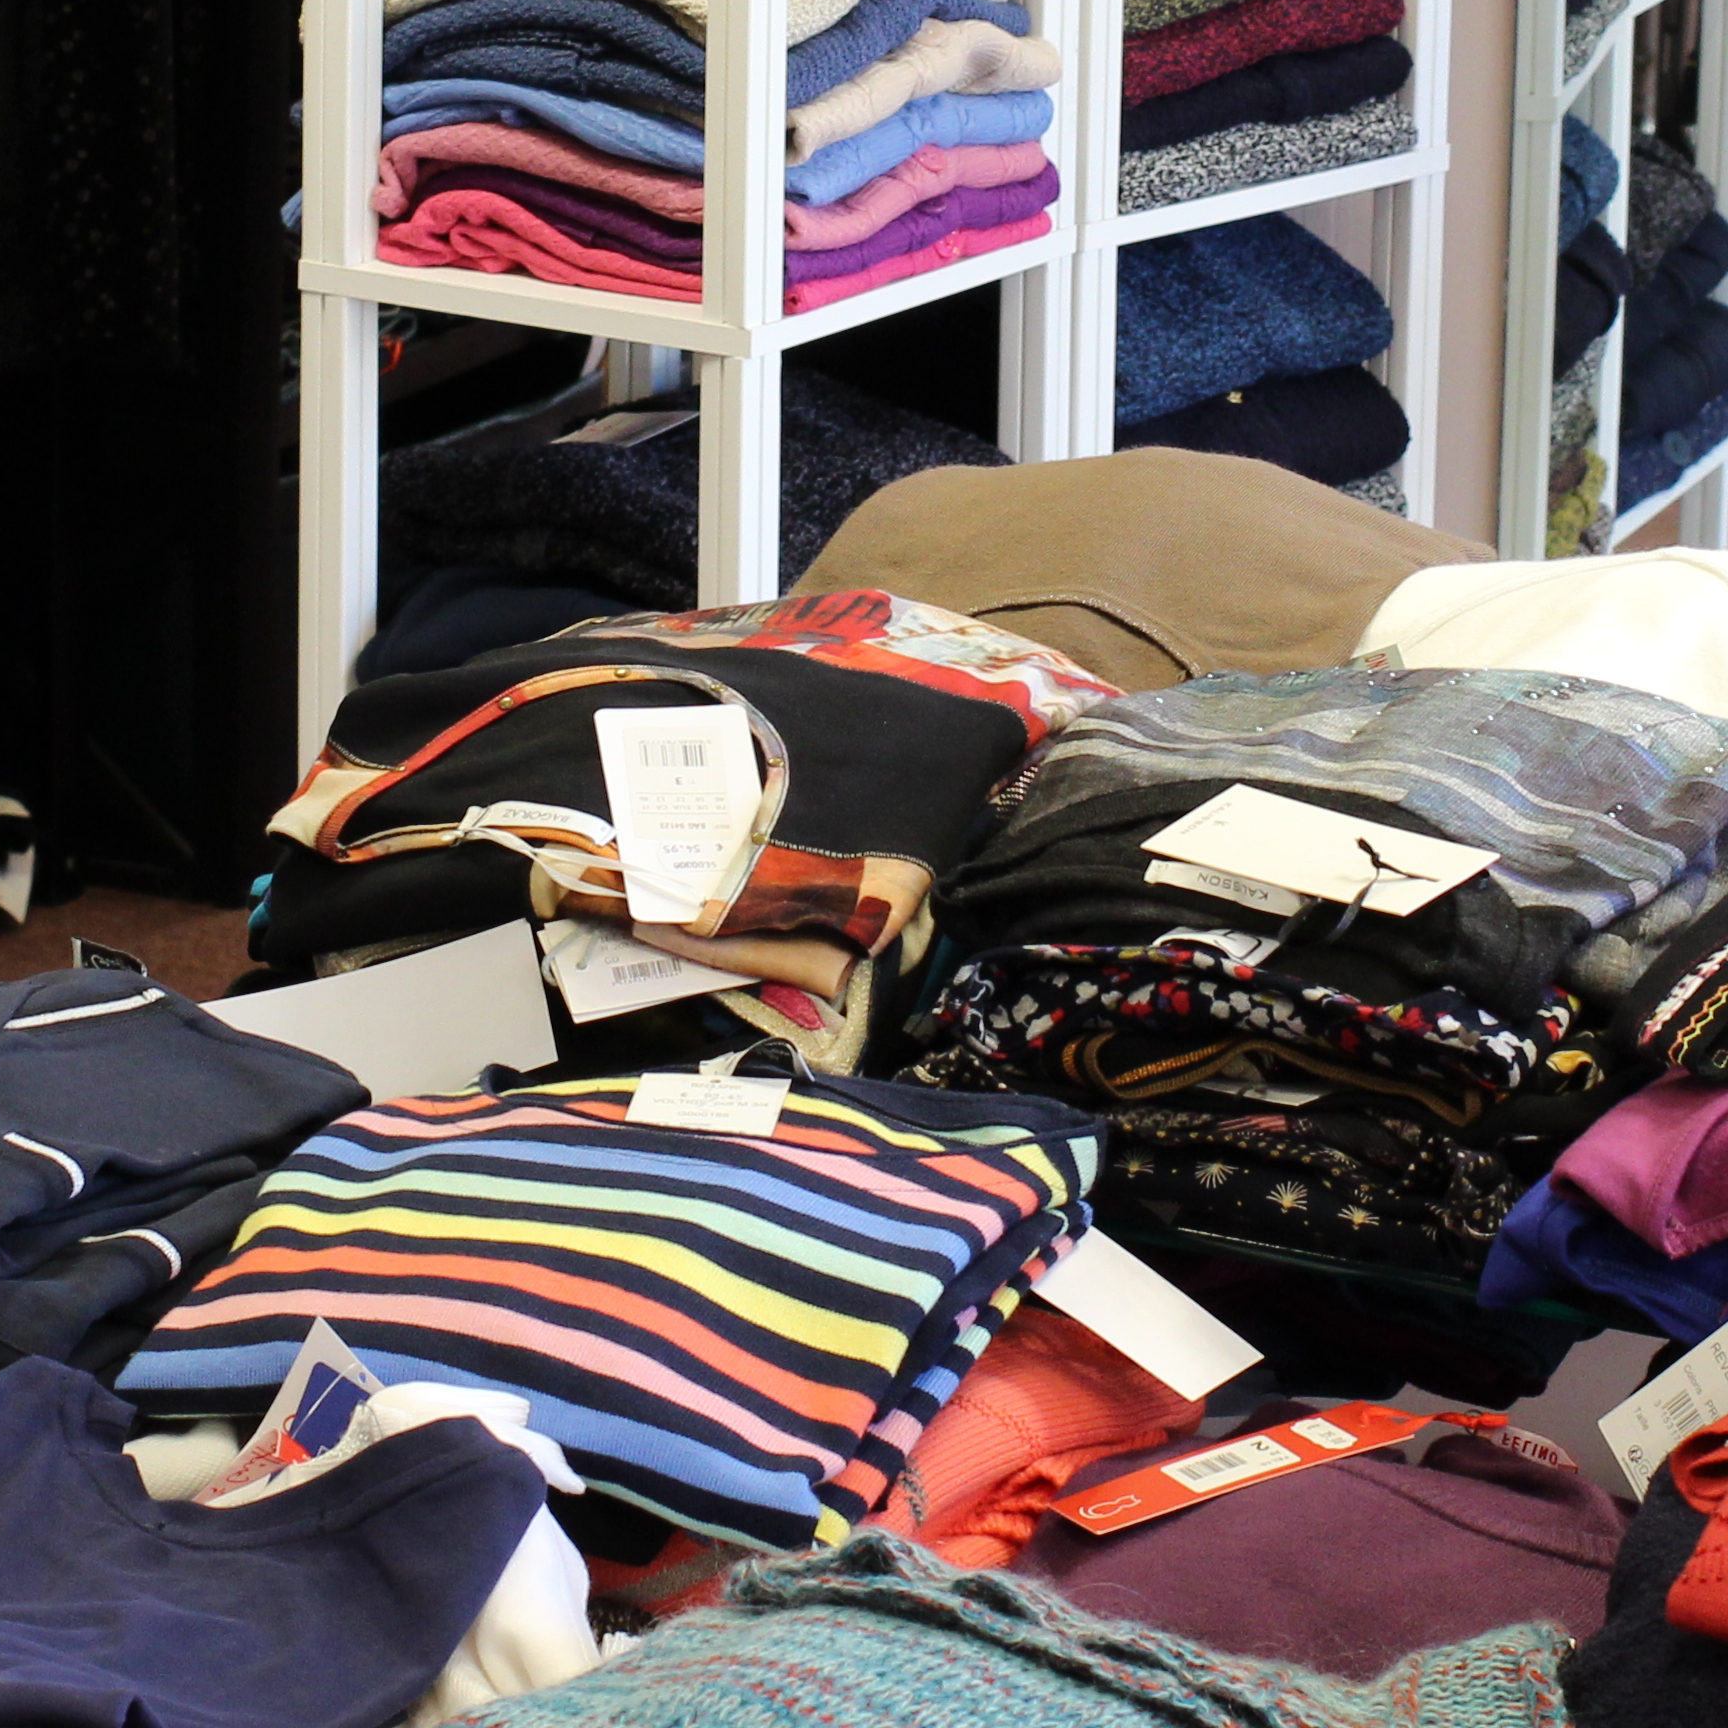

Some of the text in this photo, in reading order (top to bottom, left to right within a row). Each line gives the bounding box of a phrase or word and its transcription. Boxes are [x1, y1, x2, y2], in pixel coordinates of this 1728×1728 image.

[500, 807, 570, 823] BAGORAZ
[1683, 1364, 1703, 1394] Coloris
[1633, 1407, 1650, 1430] Taille
